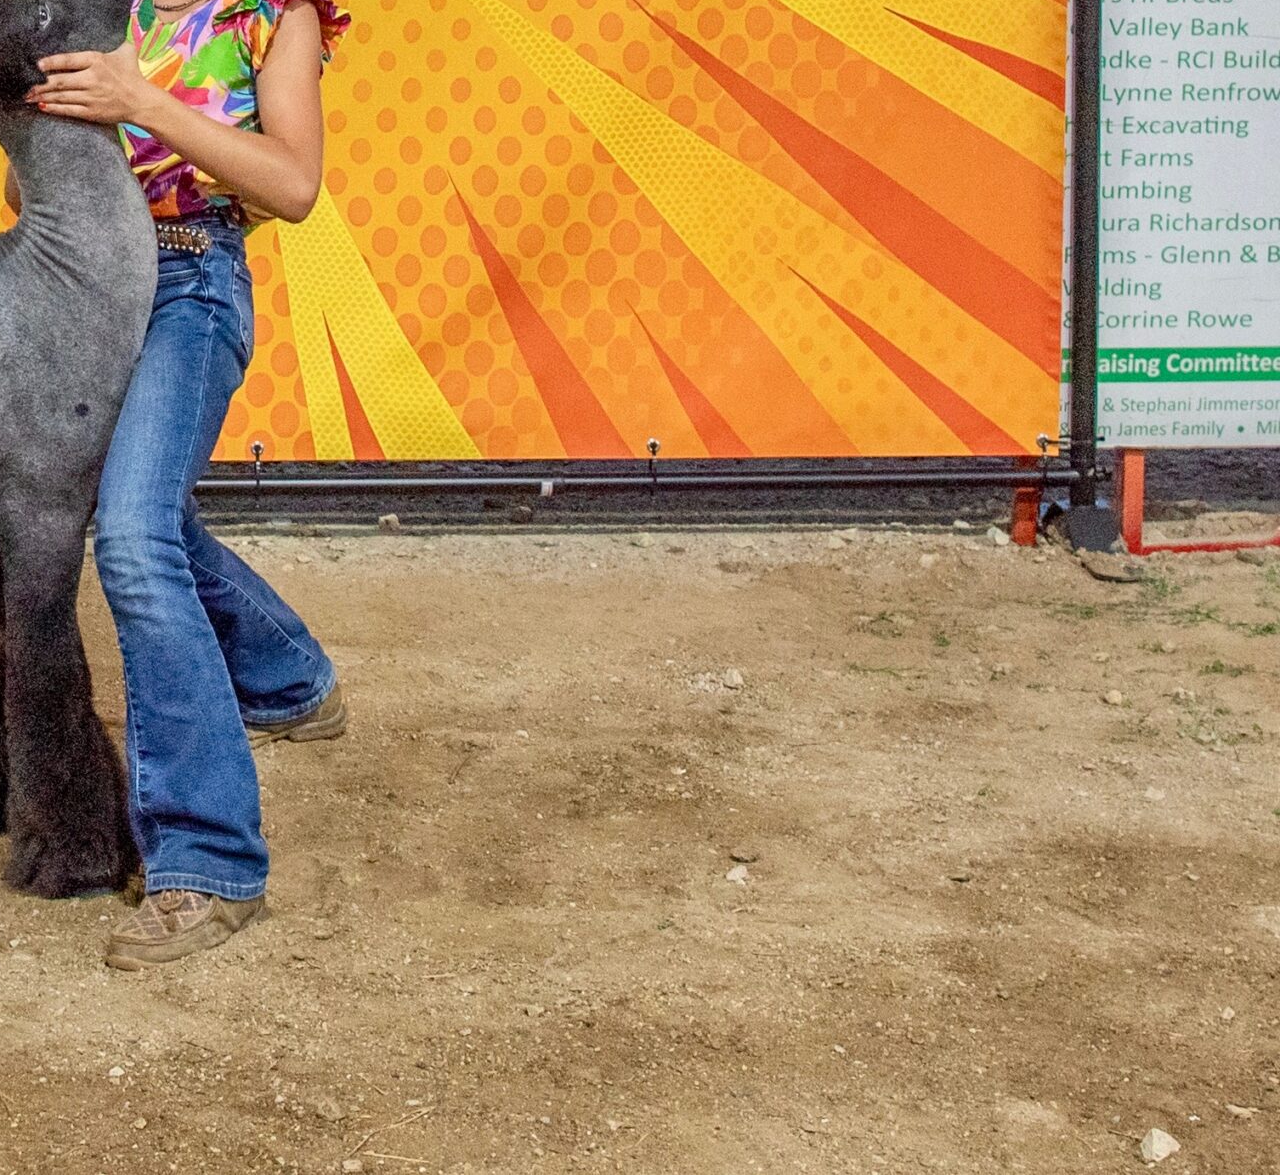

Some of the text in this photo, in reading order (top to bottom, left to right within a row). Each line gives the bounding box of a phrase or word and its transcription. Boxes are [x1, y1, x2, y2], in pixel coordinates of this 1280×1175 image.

[1109, 18, 1249, 40] Valley Bank
[1100, 50, 1152, 69] adke
[1177, 51, 1215, 69] RCI
[1102, 84, 1173, 106] Lynne
[1123, 116, 1249, 138] Excavating
[1121, 148, 1194, 167] Farms
[1102, 181, 1192, 203] umbing
[1150, 212, 1280, 232] Richardson
[1161, 245, 1231, 264] Glenn
[1240, 245, 1257, 263] &
[1188, 310, 1253, 328] Rowe
[1098, 354, 1160, 377] aising
[1102, 398, 1115, 412] &
[1120, 397, 1191, 415] Stephani
[1116, 423, 1167, 437] James
[1172, 422, 1225, 438] Family
